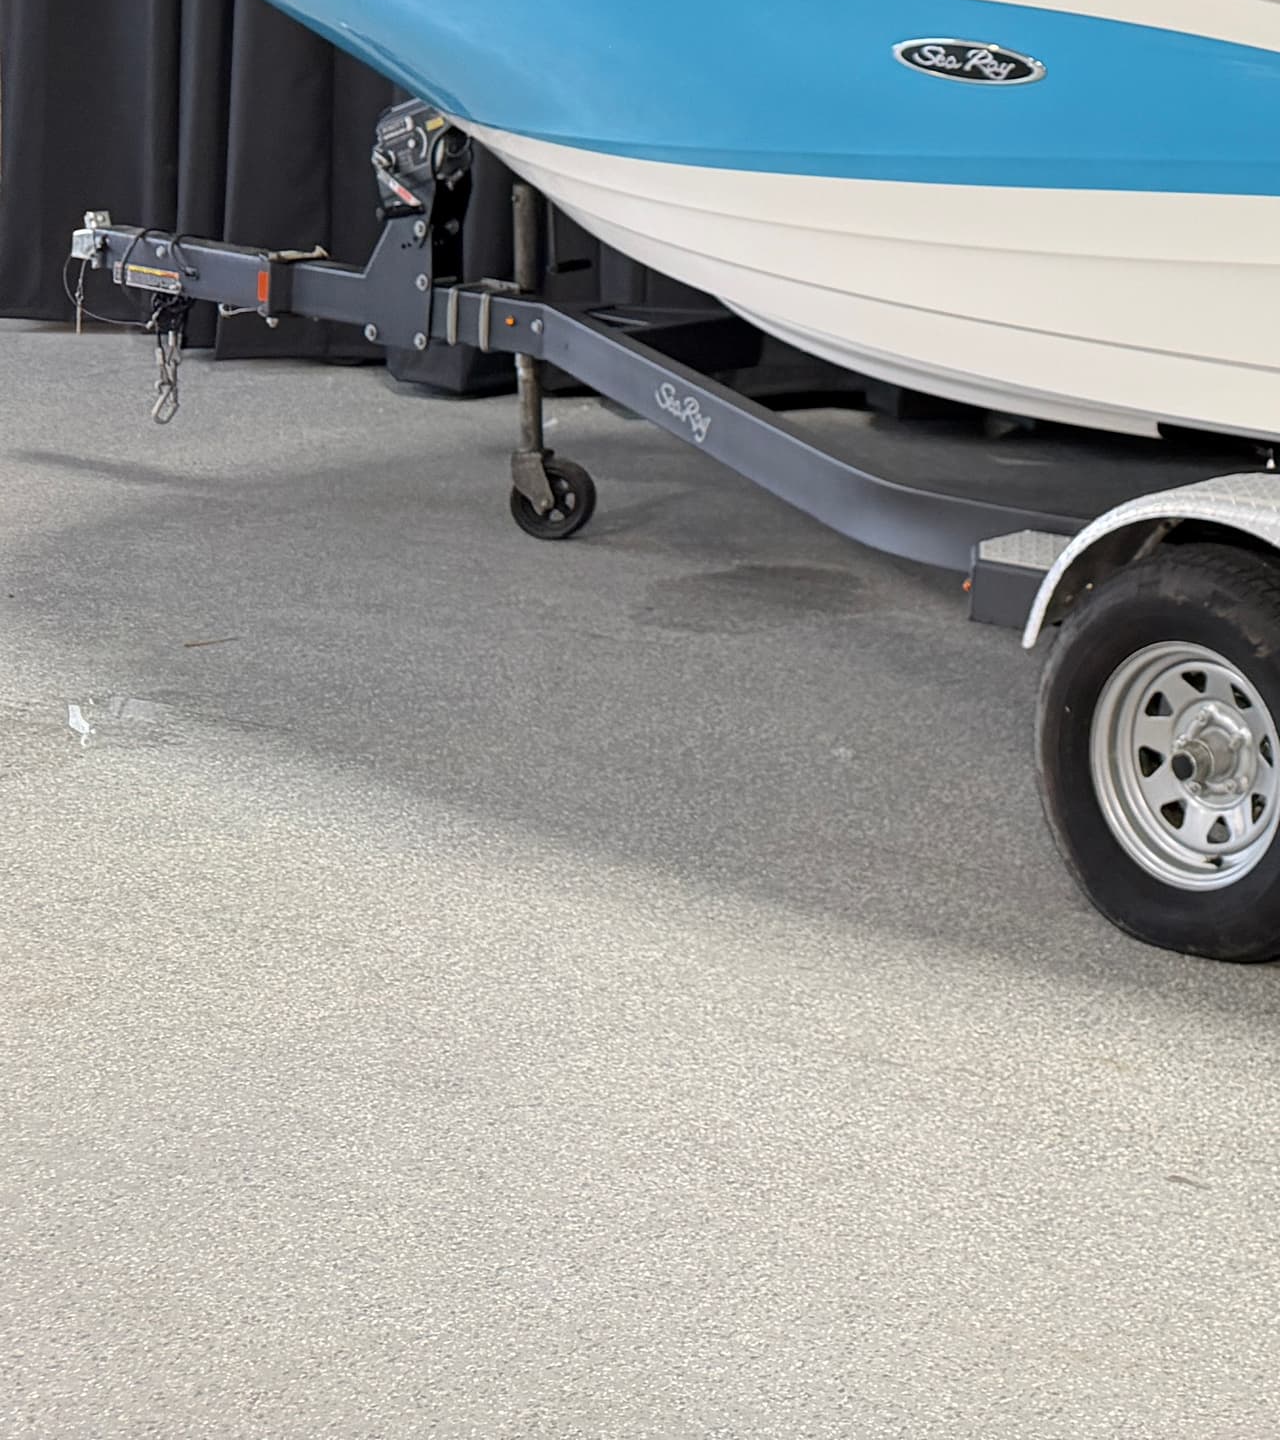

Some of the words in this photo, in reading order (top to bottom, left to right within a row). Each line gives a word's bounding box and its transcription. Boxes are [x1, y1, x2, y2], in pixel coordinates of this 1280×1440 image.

[912, 44, 962, 70] Sea
[963, 49, 1006, 80] Ray
[655, 382, 681, 416] Sea
[681, 396, 711, 443] Ray
